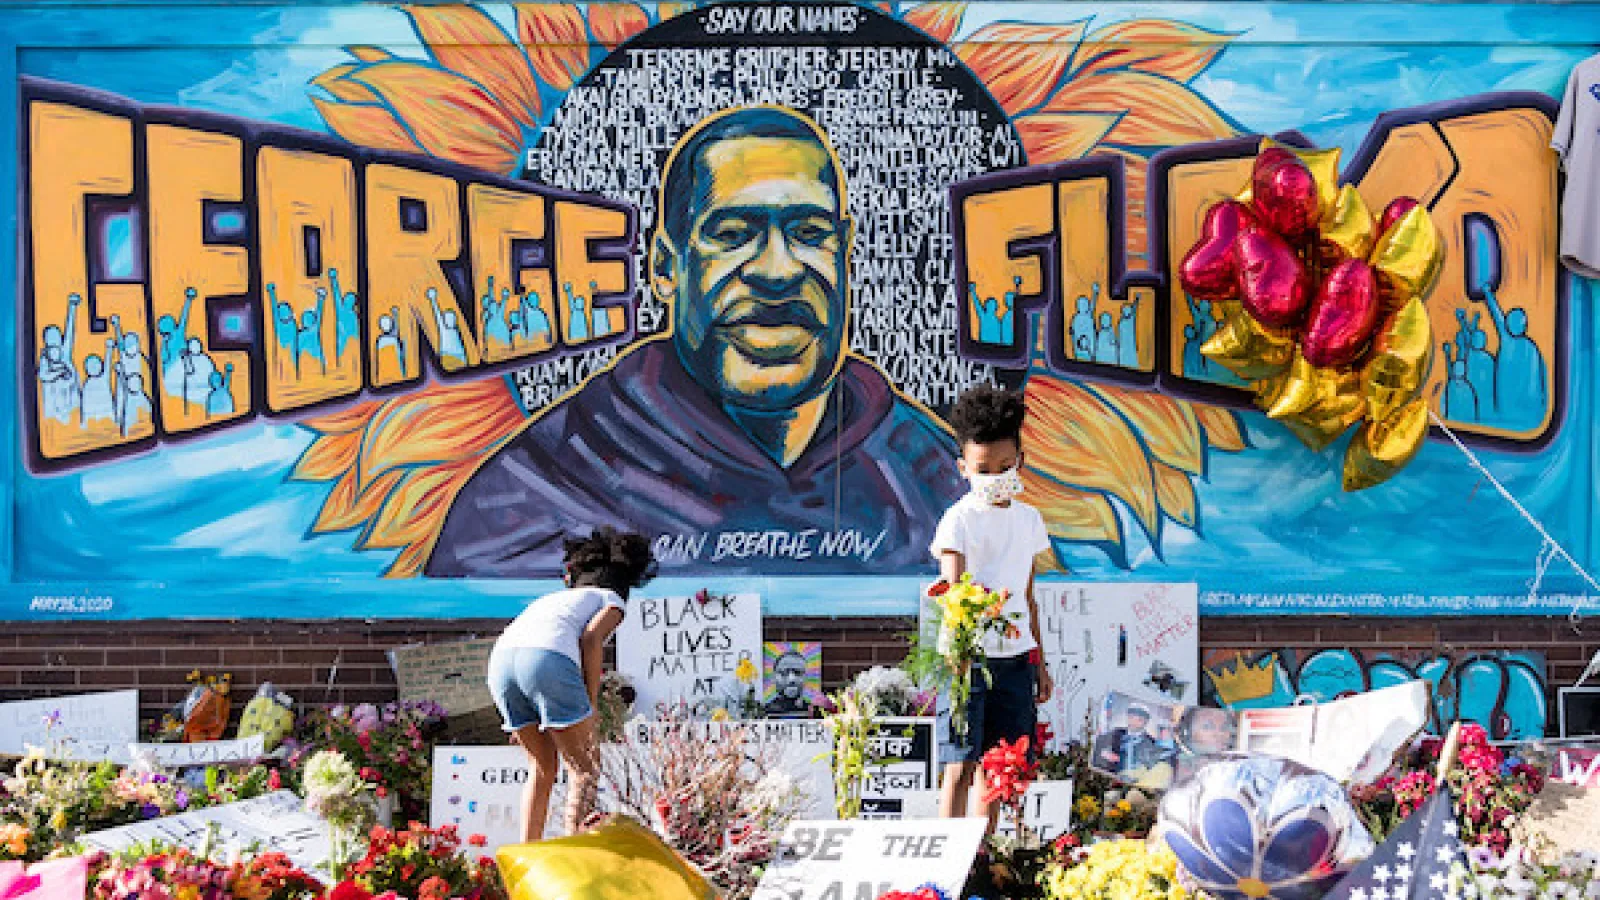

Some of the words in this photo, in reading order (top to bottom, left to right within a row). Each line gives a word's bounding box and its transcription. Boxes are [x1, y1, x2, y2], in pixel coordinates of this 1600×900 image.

[704, 7, 747, 35] SAY
[751, 7, 797, 35] OUR
[799, 6, 858, 34] NAMES
[625, 47, 732, 71] TERRENCE
[835, 47, 920, 71] JEREMY
[857, 69, 936, 91] CASTILE
[646, 107, 714, 128] BROW
[26, 88, 636, 464] GEORGE
[948, 92, 1562, 454] FLD
[654, 531, 709, 564] CAN
[710, 527, 818, 562] BREATHE
[818, 526, 887, 563] NOW
[640, 594, 737, 631] BLACK
[1037, 587, 1093, 616] TICE
[663, 625, 732, 656] LIVES
[692, 675, 721, 697] AT
[766, 721, 826, 744] MATTER
[480, 766, 530, 786] GEO
[881, 834, 949, 859] THE
